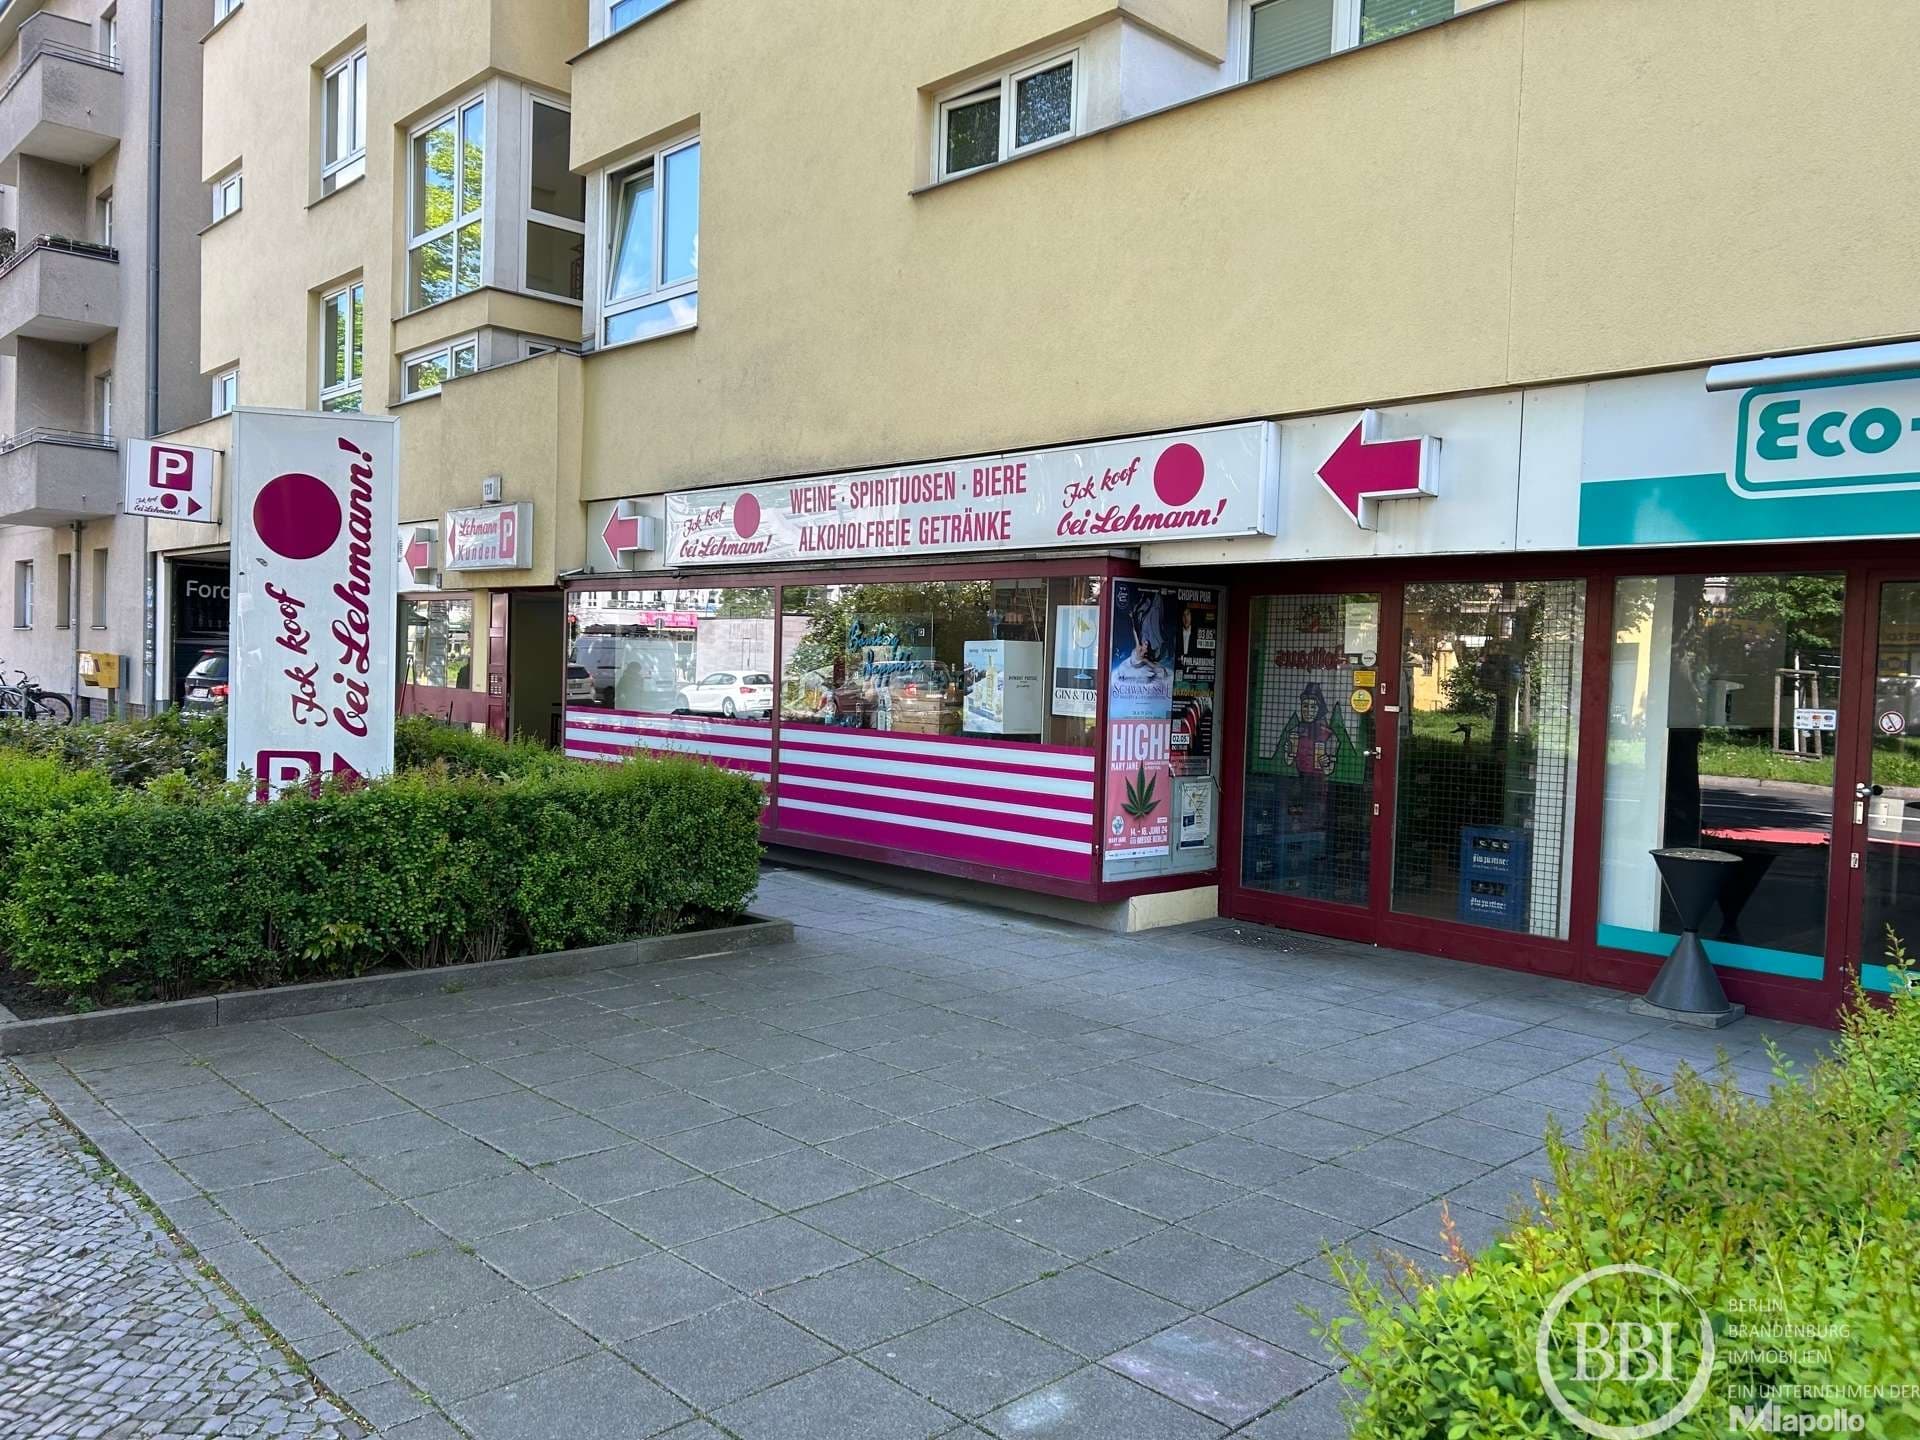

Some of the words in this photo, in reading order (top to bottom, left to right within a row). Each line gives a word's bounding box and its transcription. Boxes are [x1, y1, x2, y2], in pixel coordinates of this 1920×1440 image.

[790, 484, 837, 514] WEINE
[850, 471, 956, 510] SPIRITUOSEN
[972, 463, 1028, 498] BIERE
[1101, 456, 1141, 492] koof
[458, 517, 499, 538] Lehmann
[798, 518, 911, 552] ALKOHOLFREIE
[918, 507, 1012, 545] GETRÄNKE
[1056, 508, 1091, 537] bei
[1089, 497, 1228, 535] Lehmann!
[331, 436, 374, 675] Lehmann!
[457, 543, 497, 562] Kunden
[680, 539, 700, 558] bei
[700, 534, 773, 558] Lehmann!
[264, 581, 311, 656] koof
[332, 672, 369, 738] bei
[1055, 689, 1073, 700] GIN
[1111, 722, 1171, 761] HIGH!
